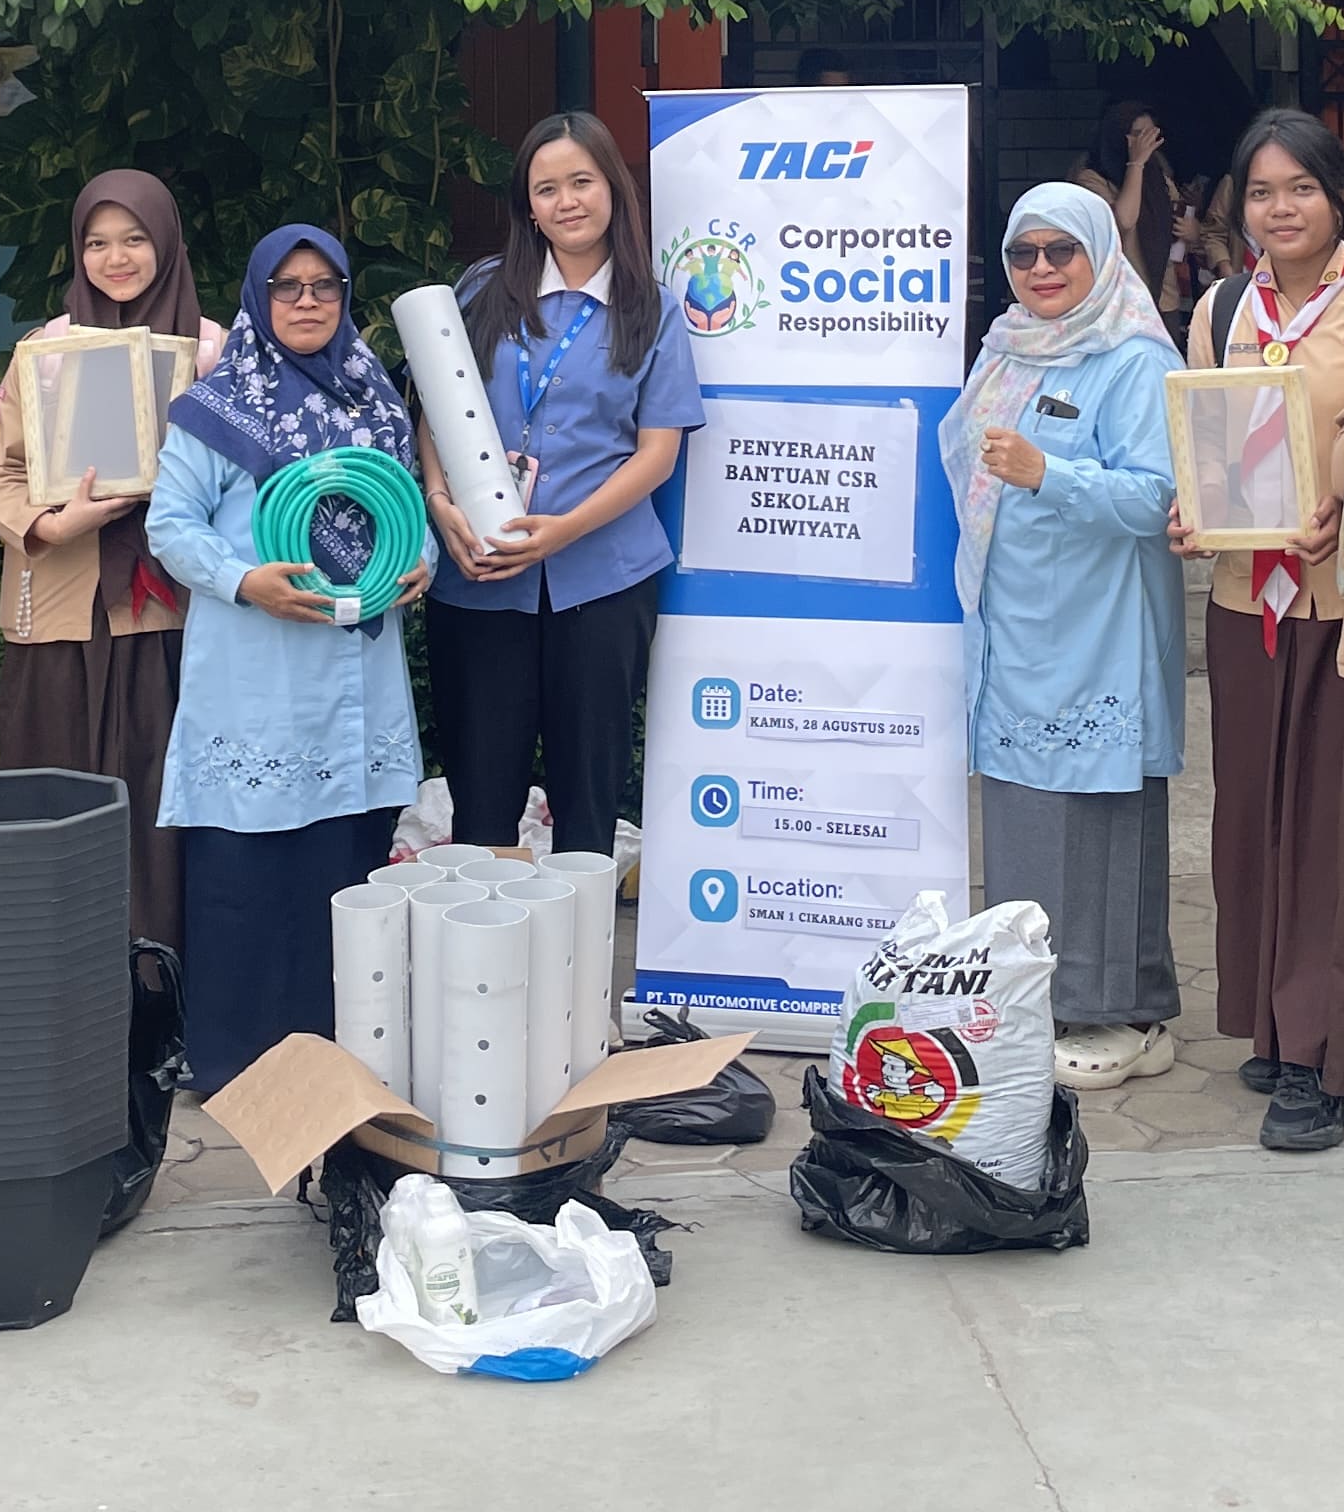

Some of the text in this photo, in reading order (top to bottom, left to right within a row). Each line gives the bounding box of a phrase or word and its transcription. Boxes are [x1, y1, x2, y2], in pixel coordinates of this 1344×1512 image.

[708, 218, 757, 252] CSR
[779, 224, 953, 258] Corporate
[780, 255, 951, 303] Social
[778, 312, 950, 338] Responsibility
[729, 439, 876, 462] PENYERAHAN
[725, 464, 878, 489] BANTUAN CSR
[751, 491, 851, 513] SEKOLAH
[737, 516, 862, 540] ADIWIYATA
[749, 683, 803, 703] Date:
[750, 716, 920, 736] KAMIS, 28 AGUSTUS 2025
[747, 780, 804, 802] Time:
[774, 818, 812, 832] 15.00
[826, 821, 888, 838] SELESAI
[747, 875, 844, 899] Location:
[749, 908, 785, 921] SMAN
[788, 912, 794, 922] 1
[798, 912, 863, 928] CIKARANG
[901, 969, 993, 995] TANI
[646, 991, 666, 1004] PT.
[669, 992, 687, 1005] TD
[689, 996, 778, 1011] AUTOMOTIVE
